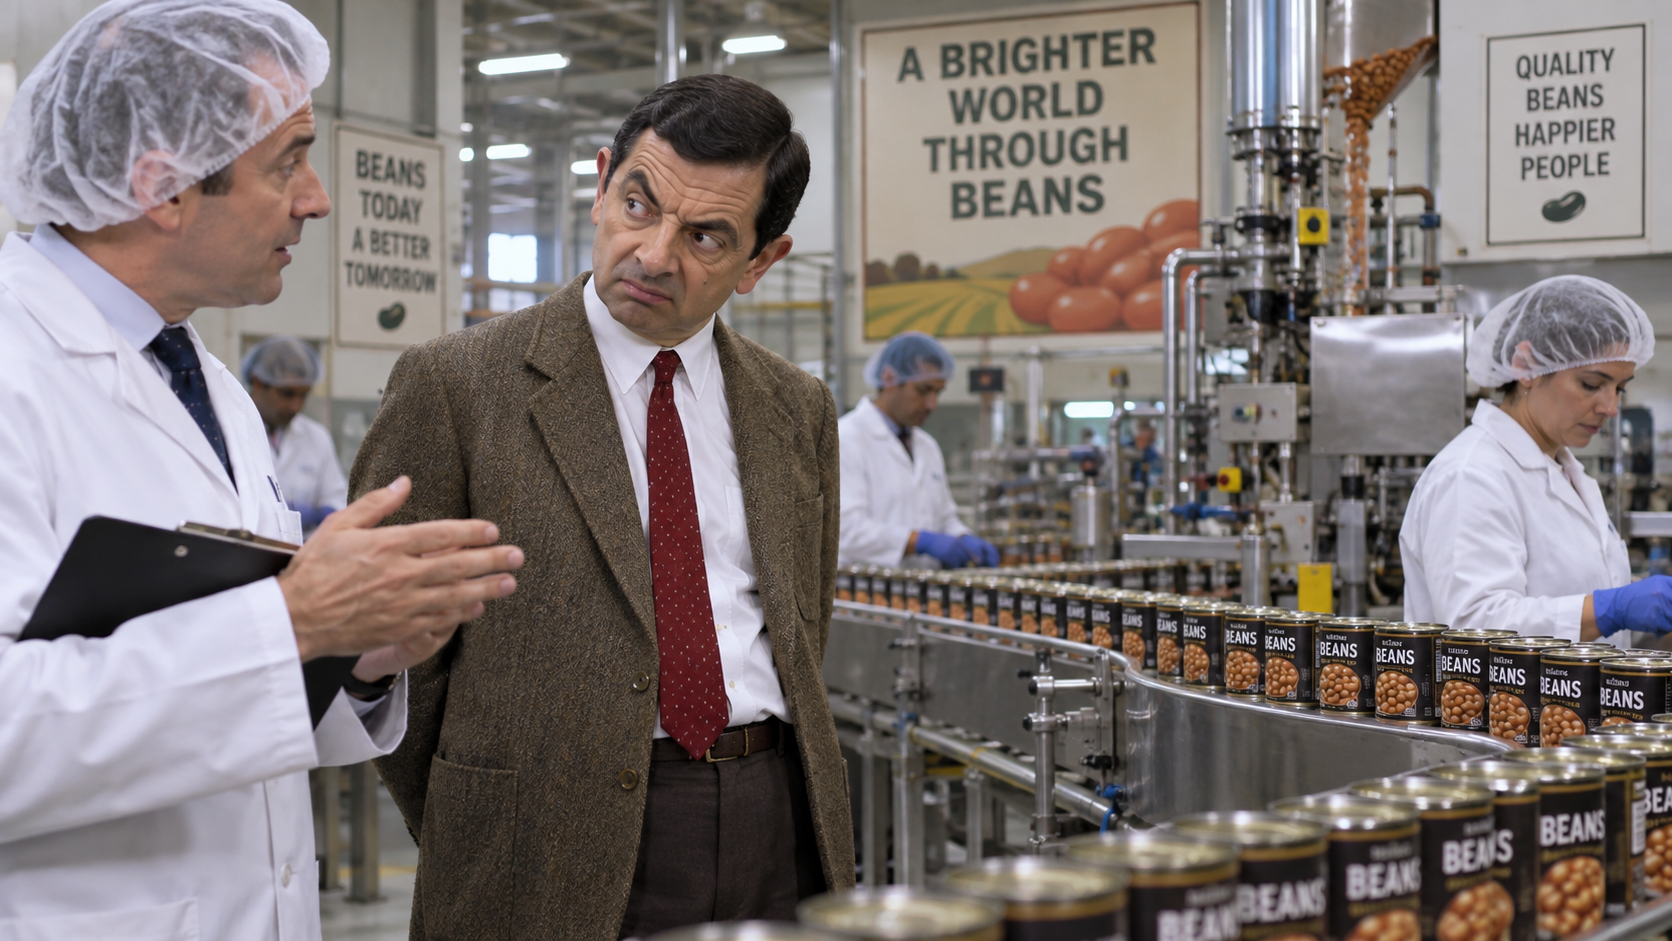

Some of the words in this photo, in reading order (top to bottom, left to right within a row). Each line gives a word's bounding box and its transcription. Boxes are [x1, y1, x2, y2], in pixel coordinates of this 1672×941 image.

[898, 46, 925, 83] A
[940, 27, 1156, 80] BRIGHTER
[1516, 47, 1615, 81] QUALITY
[949, 80, 1104, 125] WORLD
[1527, 83, 1604, 112] BEANS
[1515, 117, 1616, 147] HAPPIER
[923, 125, 1128, 173] THROUGH
[356, 149, 426, 189] BEANS
[1521, 152, 1610, 180] PEOPLE
[359, 188, 424, 225] TODAY
[950, 174, 1105, 220] BEANS
[352, 227, 364, 254] A
[369, 228, 431, 261] BETTER
[344, 260, 438, 294] TOMORROW
[1225, 628, 1257, 645] BEANS
[1265, 635, 1296, 652] BEANS
[1320, 641, 1358, 658] BEANS
[1376, 647, 1415, 665] BEANS
[1441, 655, 1481, 674] BEANS
[1489, 665, 1526, 686] BEANS
[1540, 676, 1582, 698] BEANS
[1600, 687, 1644, 710] BEANS
[1540, 809, 1606, 847] BEANS
